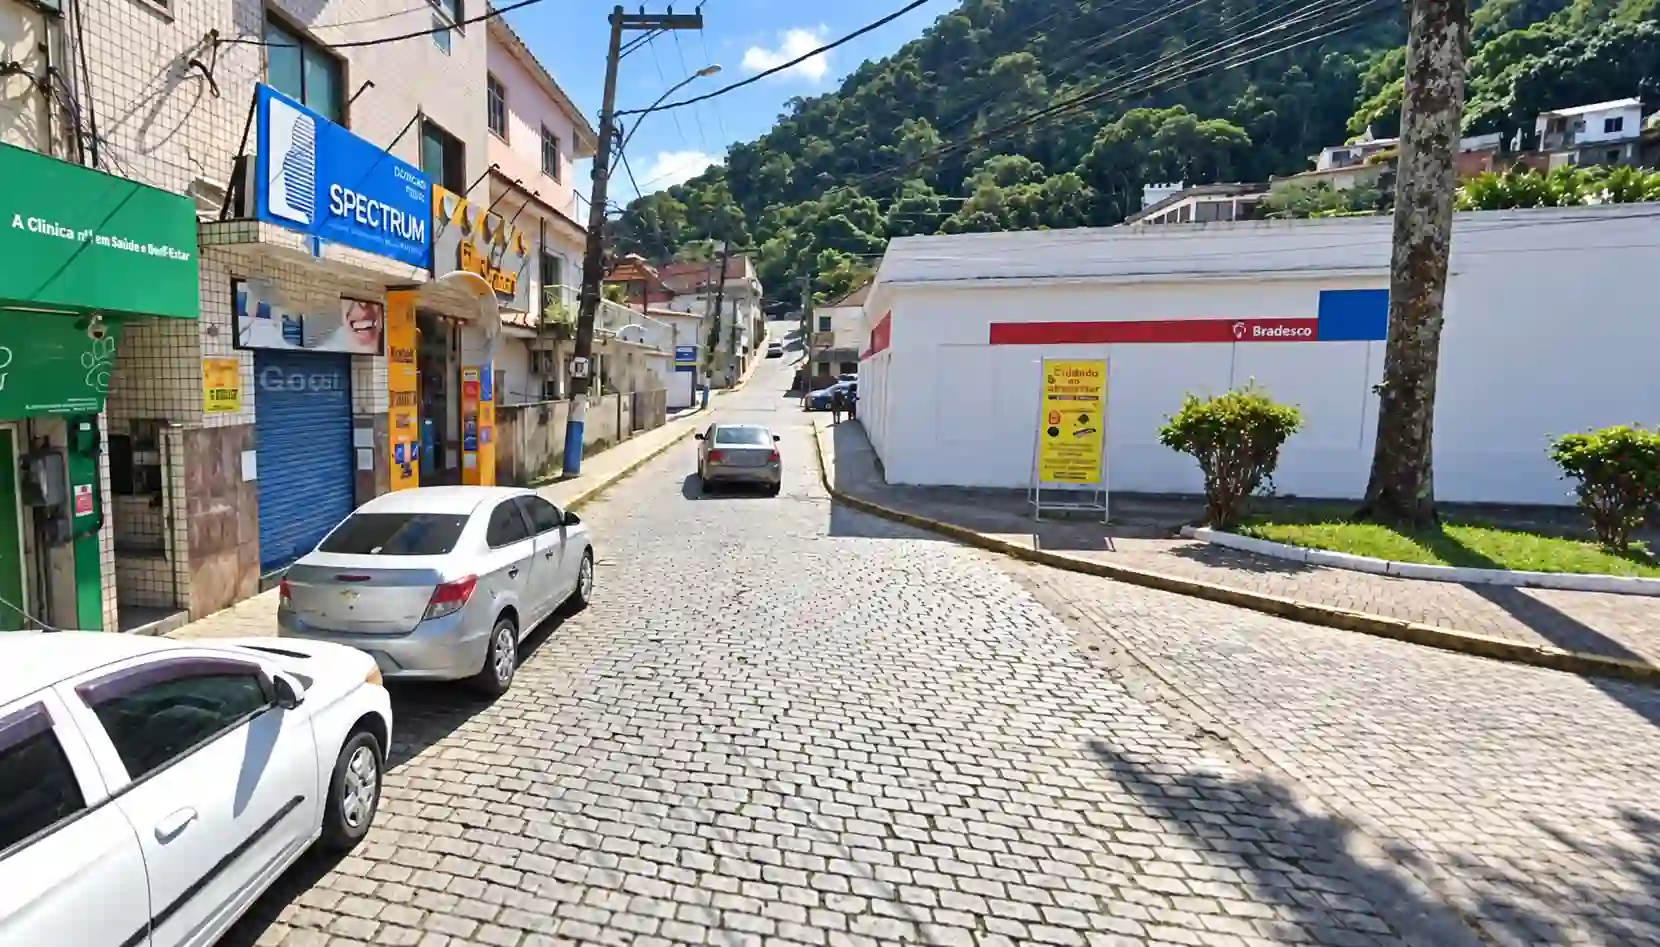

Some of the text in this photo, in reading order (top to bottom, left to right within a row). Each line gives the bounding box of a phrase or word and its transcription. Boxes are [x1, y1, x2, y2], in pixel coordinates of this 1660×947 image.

[11, 213, 25, 230] A
[95, 235, 110, 247] em
[329, 183, 425, 245] SPECTRUM
[1252, 325, 1312, 337] Bradesco
